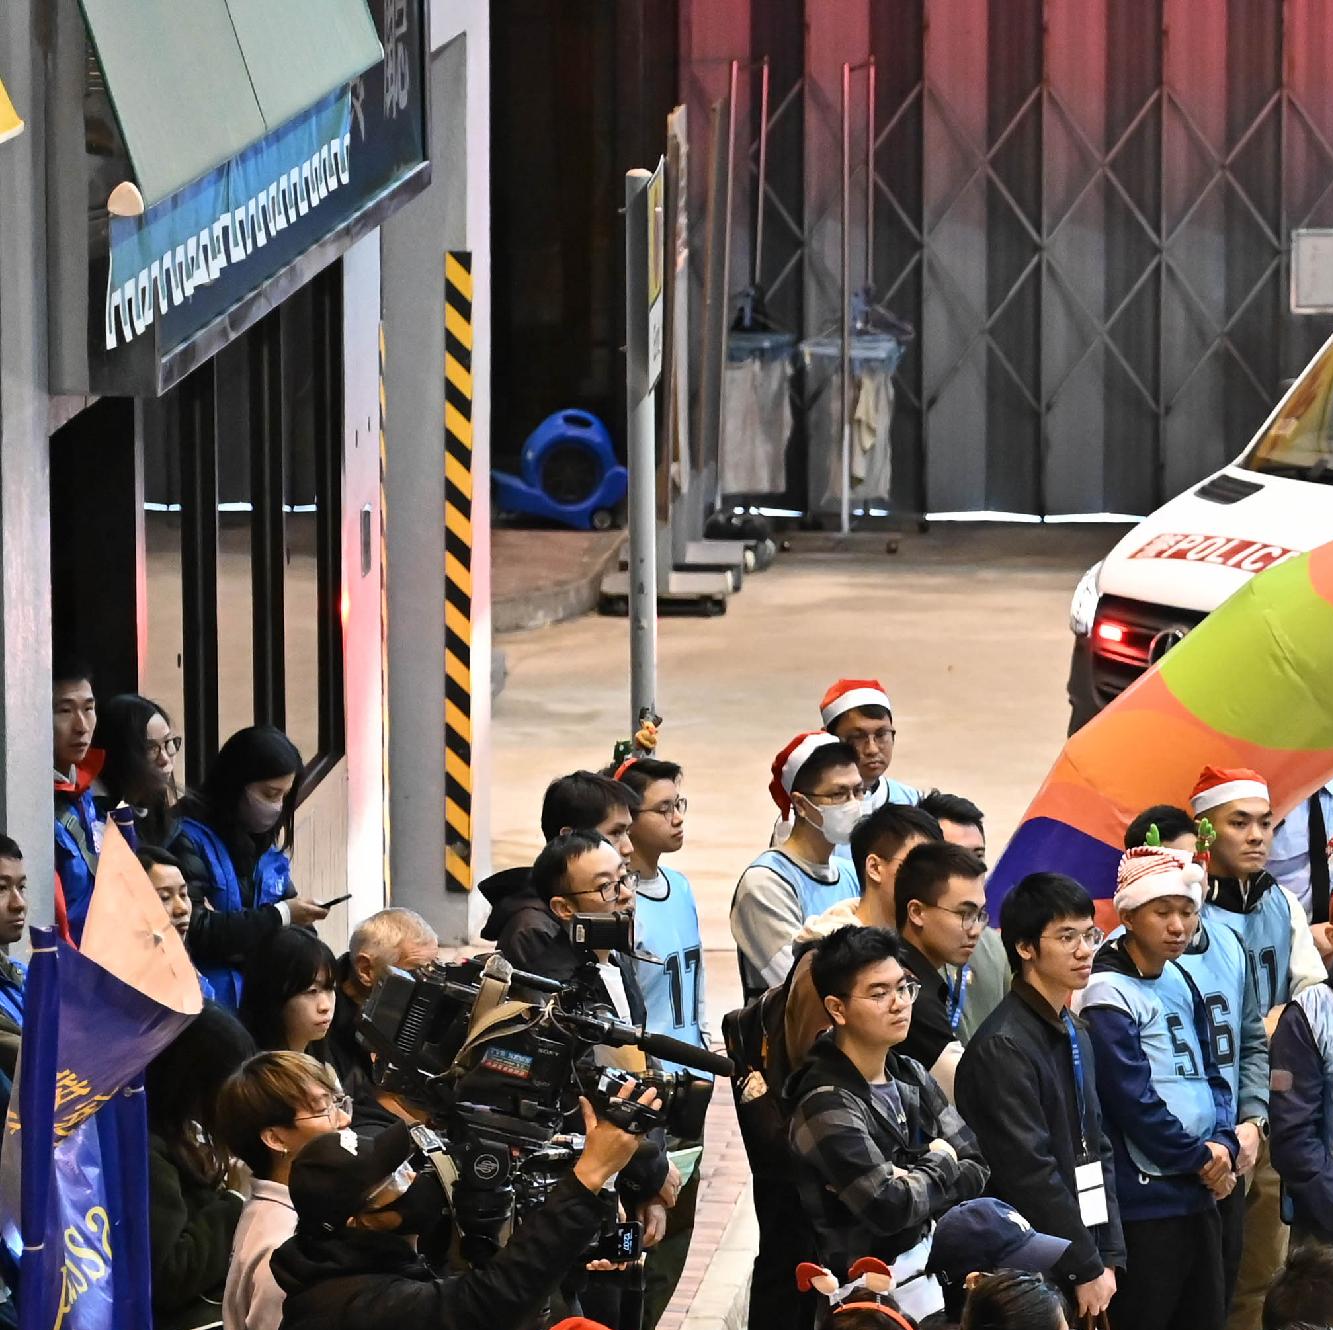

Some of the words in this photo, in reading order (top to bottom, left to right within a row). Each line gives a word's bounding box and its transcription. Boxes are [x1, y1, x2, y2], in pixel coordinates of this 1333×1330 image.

[663, 944, 701, 1030] 17
[1165, 1012, 1200, 1080] 5
[1203, 991, 1236, 1068] 6
